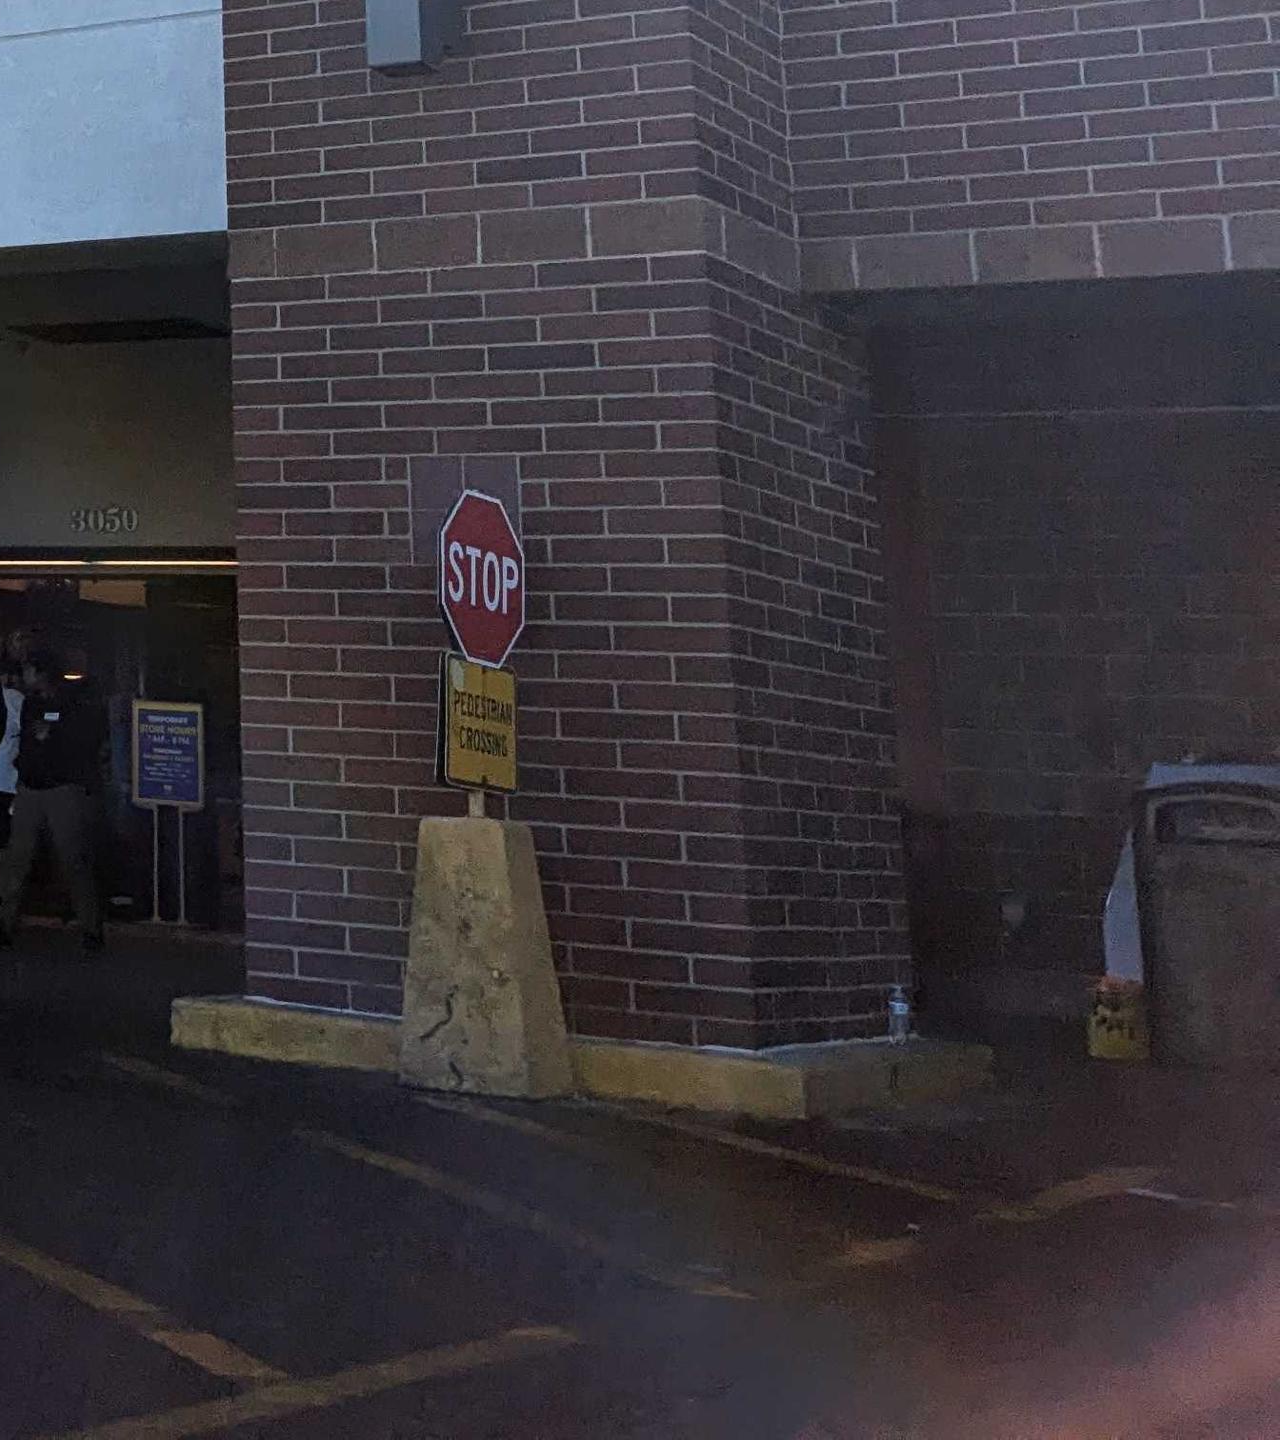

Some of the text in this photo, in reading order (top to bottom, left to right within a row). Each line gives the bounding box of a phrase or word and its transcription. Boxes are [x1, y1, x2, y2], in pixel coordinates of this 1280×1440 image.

[71, 506, 138, 532] 3050
[448, 541, 518, 614] STOP
[453, 688, 513, 724] PEDESTRIAN
[459, 725, 508, 757] CROSSING
